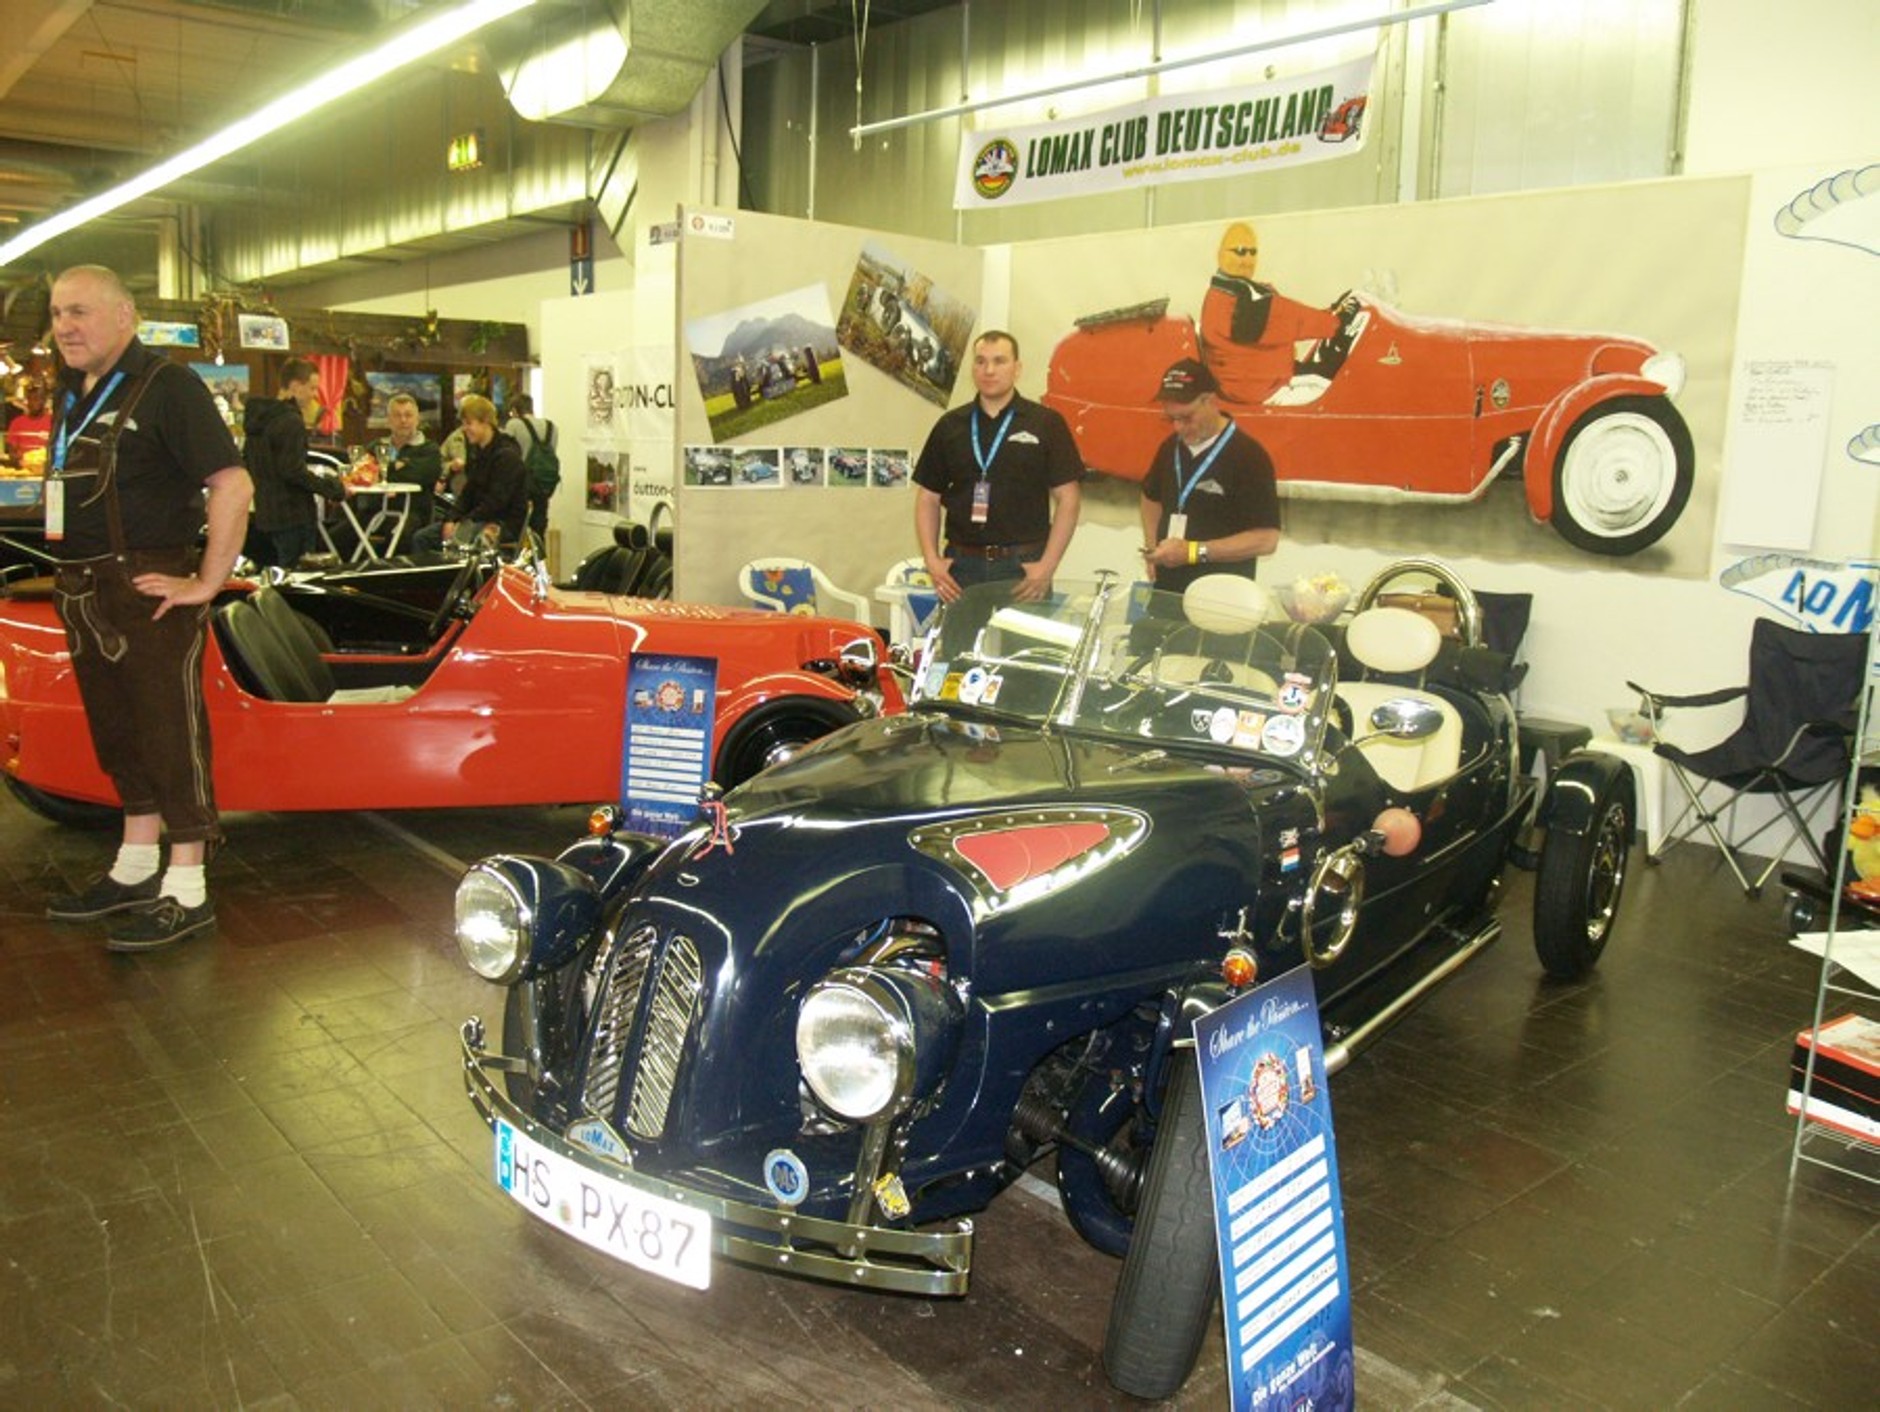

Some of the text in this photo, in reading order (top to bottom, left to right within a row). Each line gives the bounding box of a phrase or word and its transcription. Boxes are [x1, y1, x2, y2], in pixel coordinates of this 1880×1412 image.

[1026, 84, 1334, 178] LOMAX CLUB DEUTSCHLAND
[1123, 142, 1301, 178] www.lomax-club.de
[514, 1143, 551, 1209] HS
